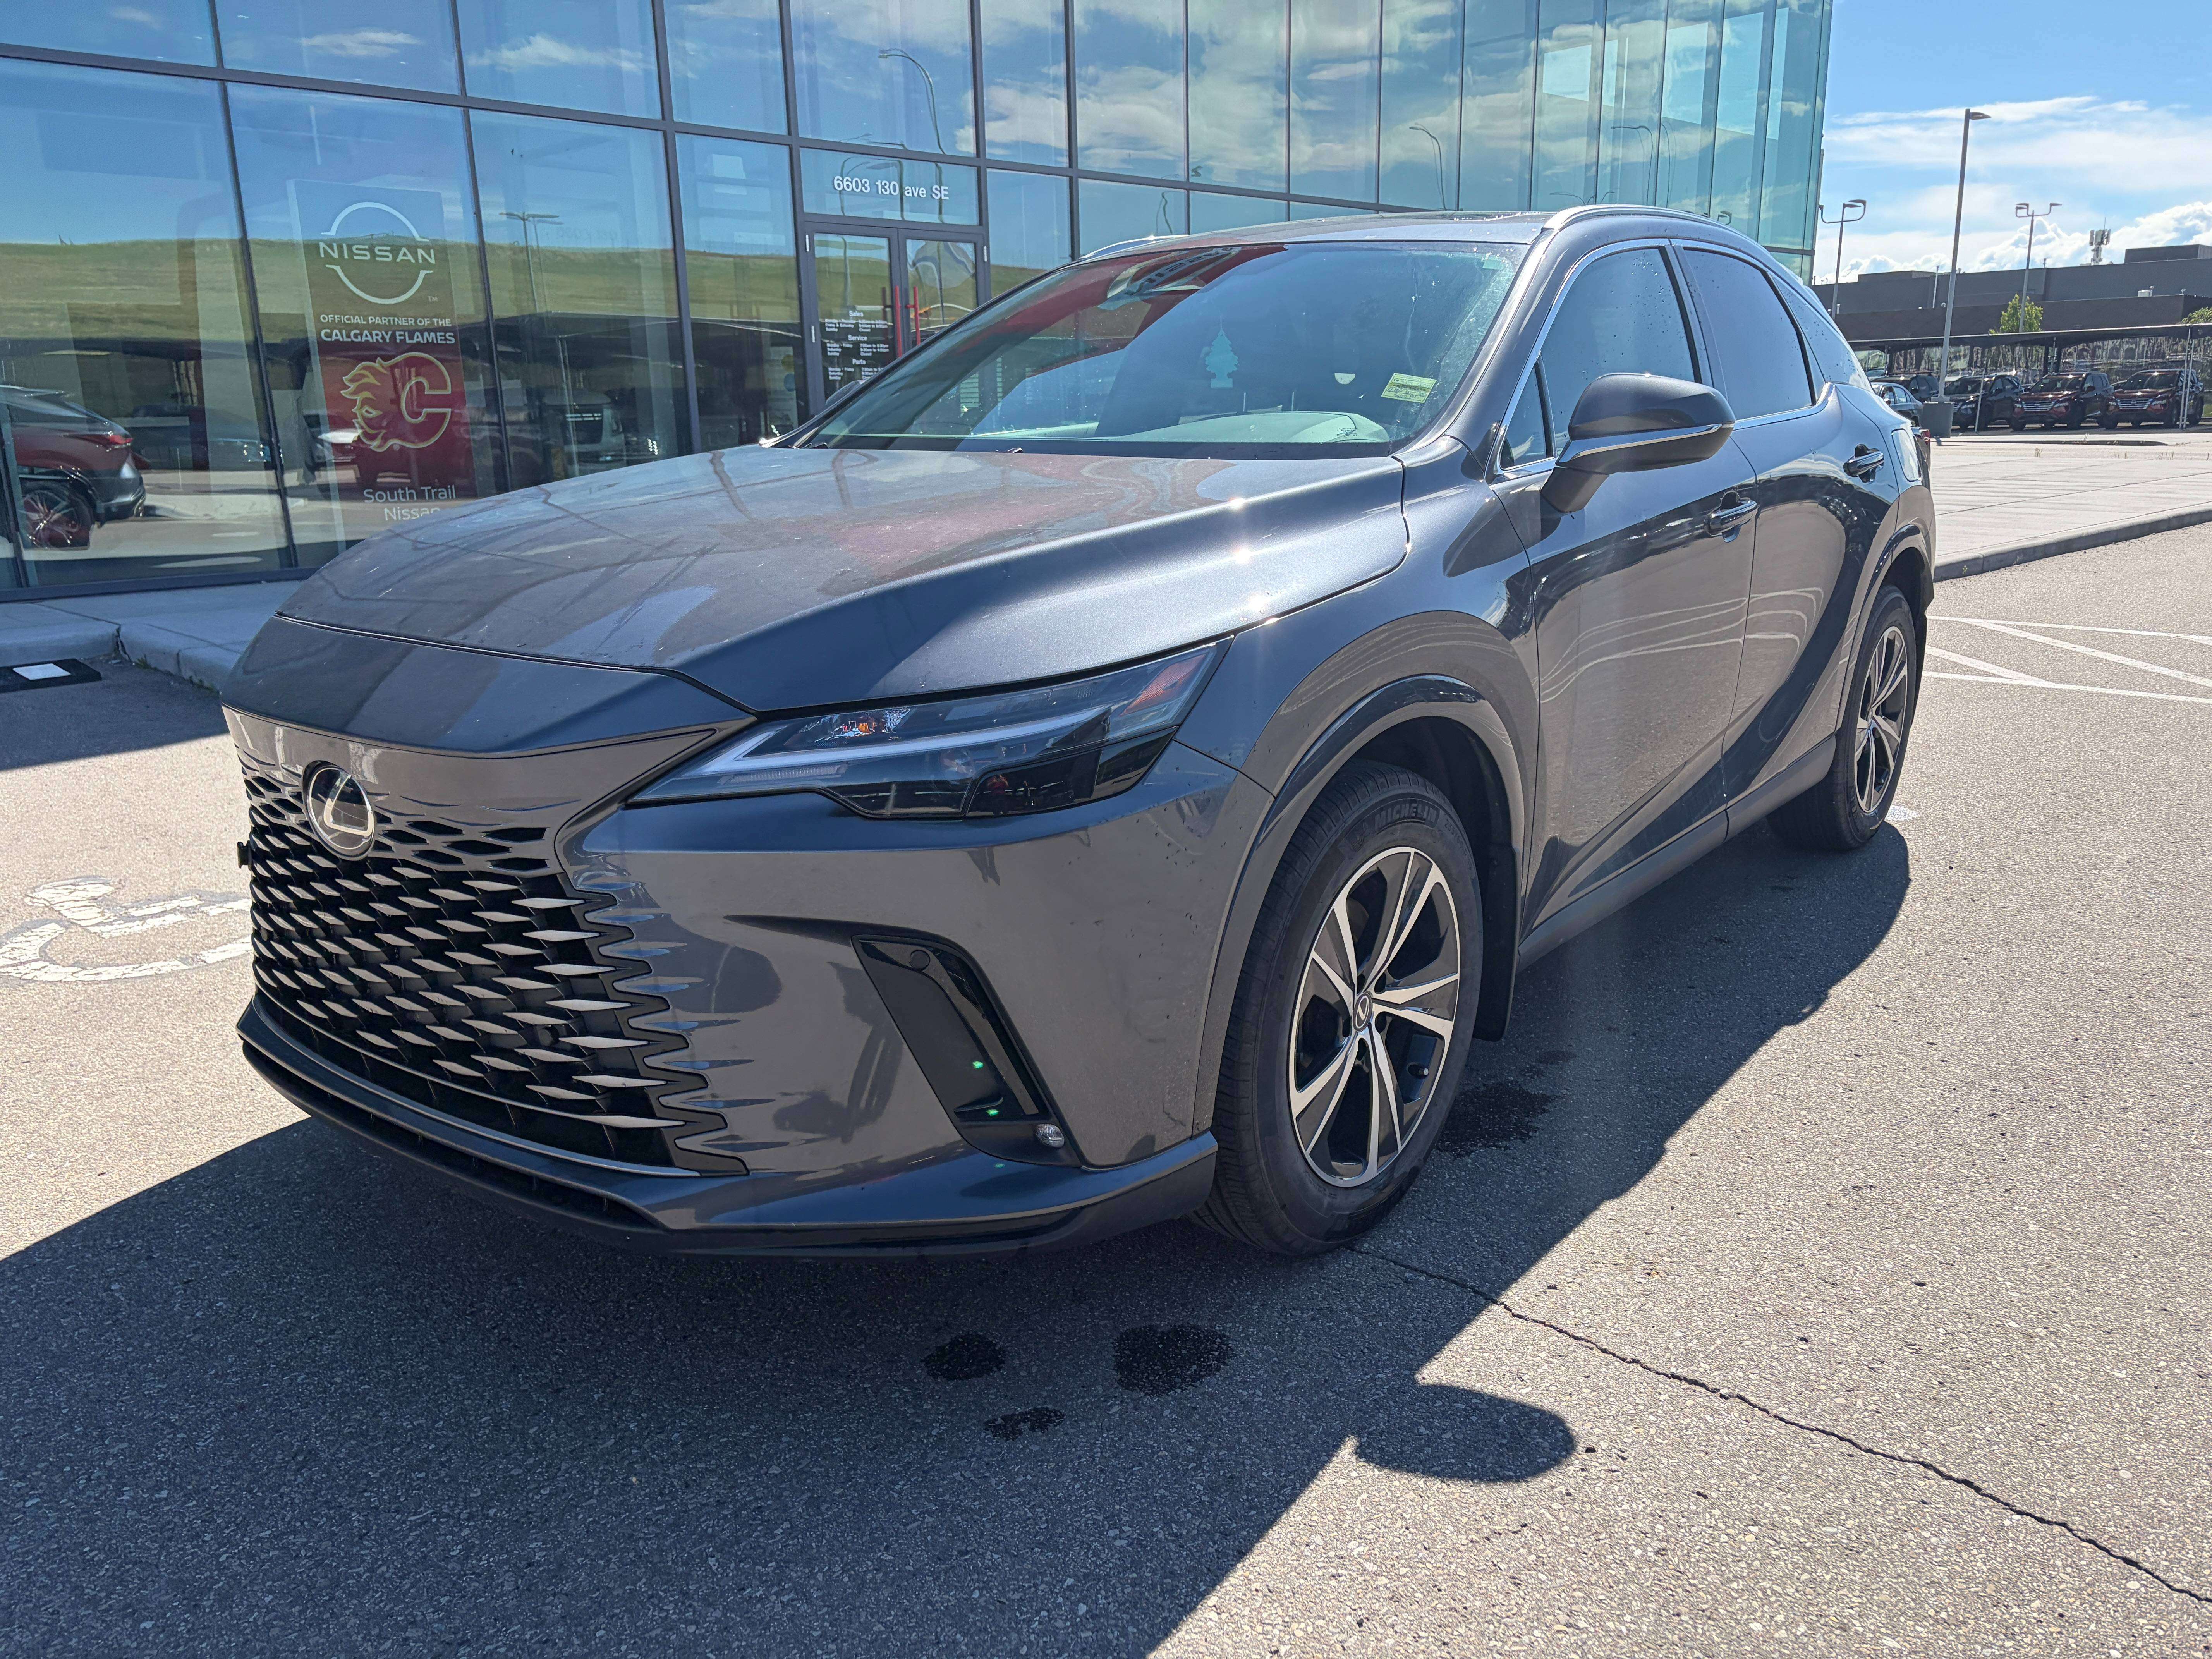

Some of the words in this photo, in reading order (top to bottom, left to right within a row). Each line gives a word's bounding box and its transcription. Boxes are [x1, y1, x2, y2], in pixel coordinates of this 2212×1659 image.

[834, 176, 870, 193] 6603
[876, 180, 900, 195] 130
[905, 186, 926, 198] ave
[932, 185, 949, 200] SE
[319, 242, 435, 264] NISSAN
[320, 314, 367, 324] OFFICIAL
[369, 316, 415, 326] PARTNER
[417, 318, 431, 326] OF
[433, 318, 452, 326] THE
[321, 329, 392, 343] CALGARY
[396, 331, 455, 344] FLAMES
[364, 487, 417, 503] South
[421, 485, 456, 500] Trail
[1374, 803, 1437, 830] MICHELIN
